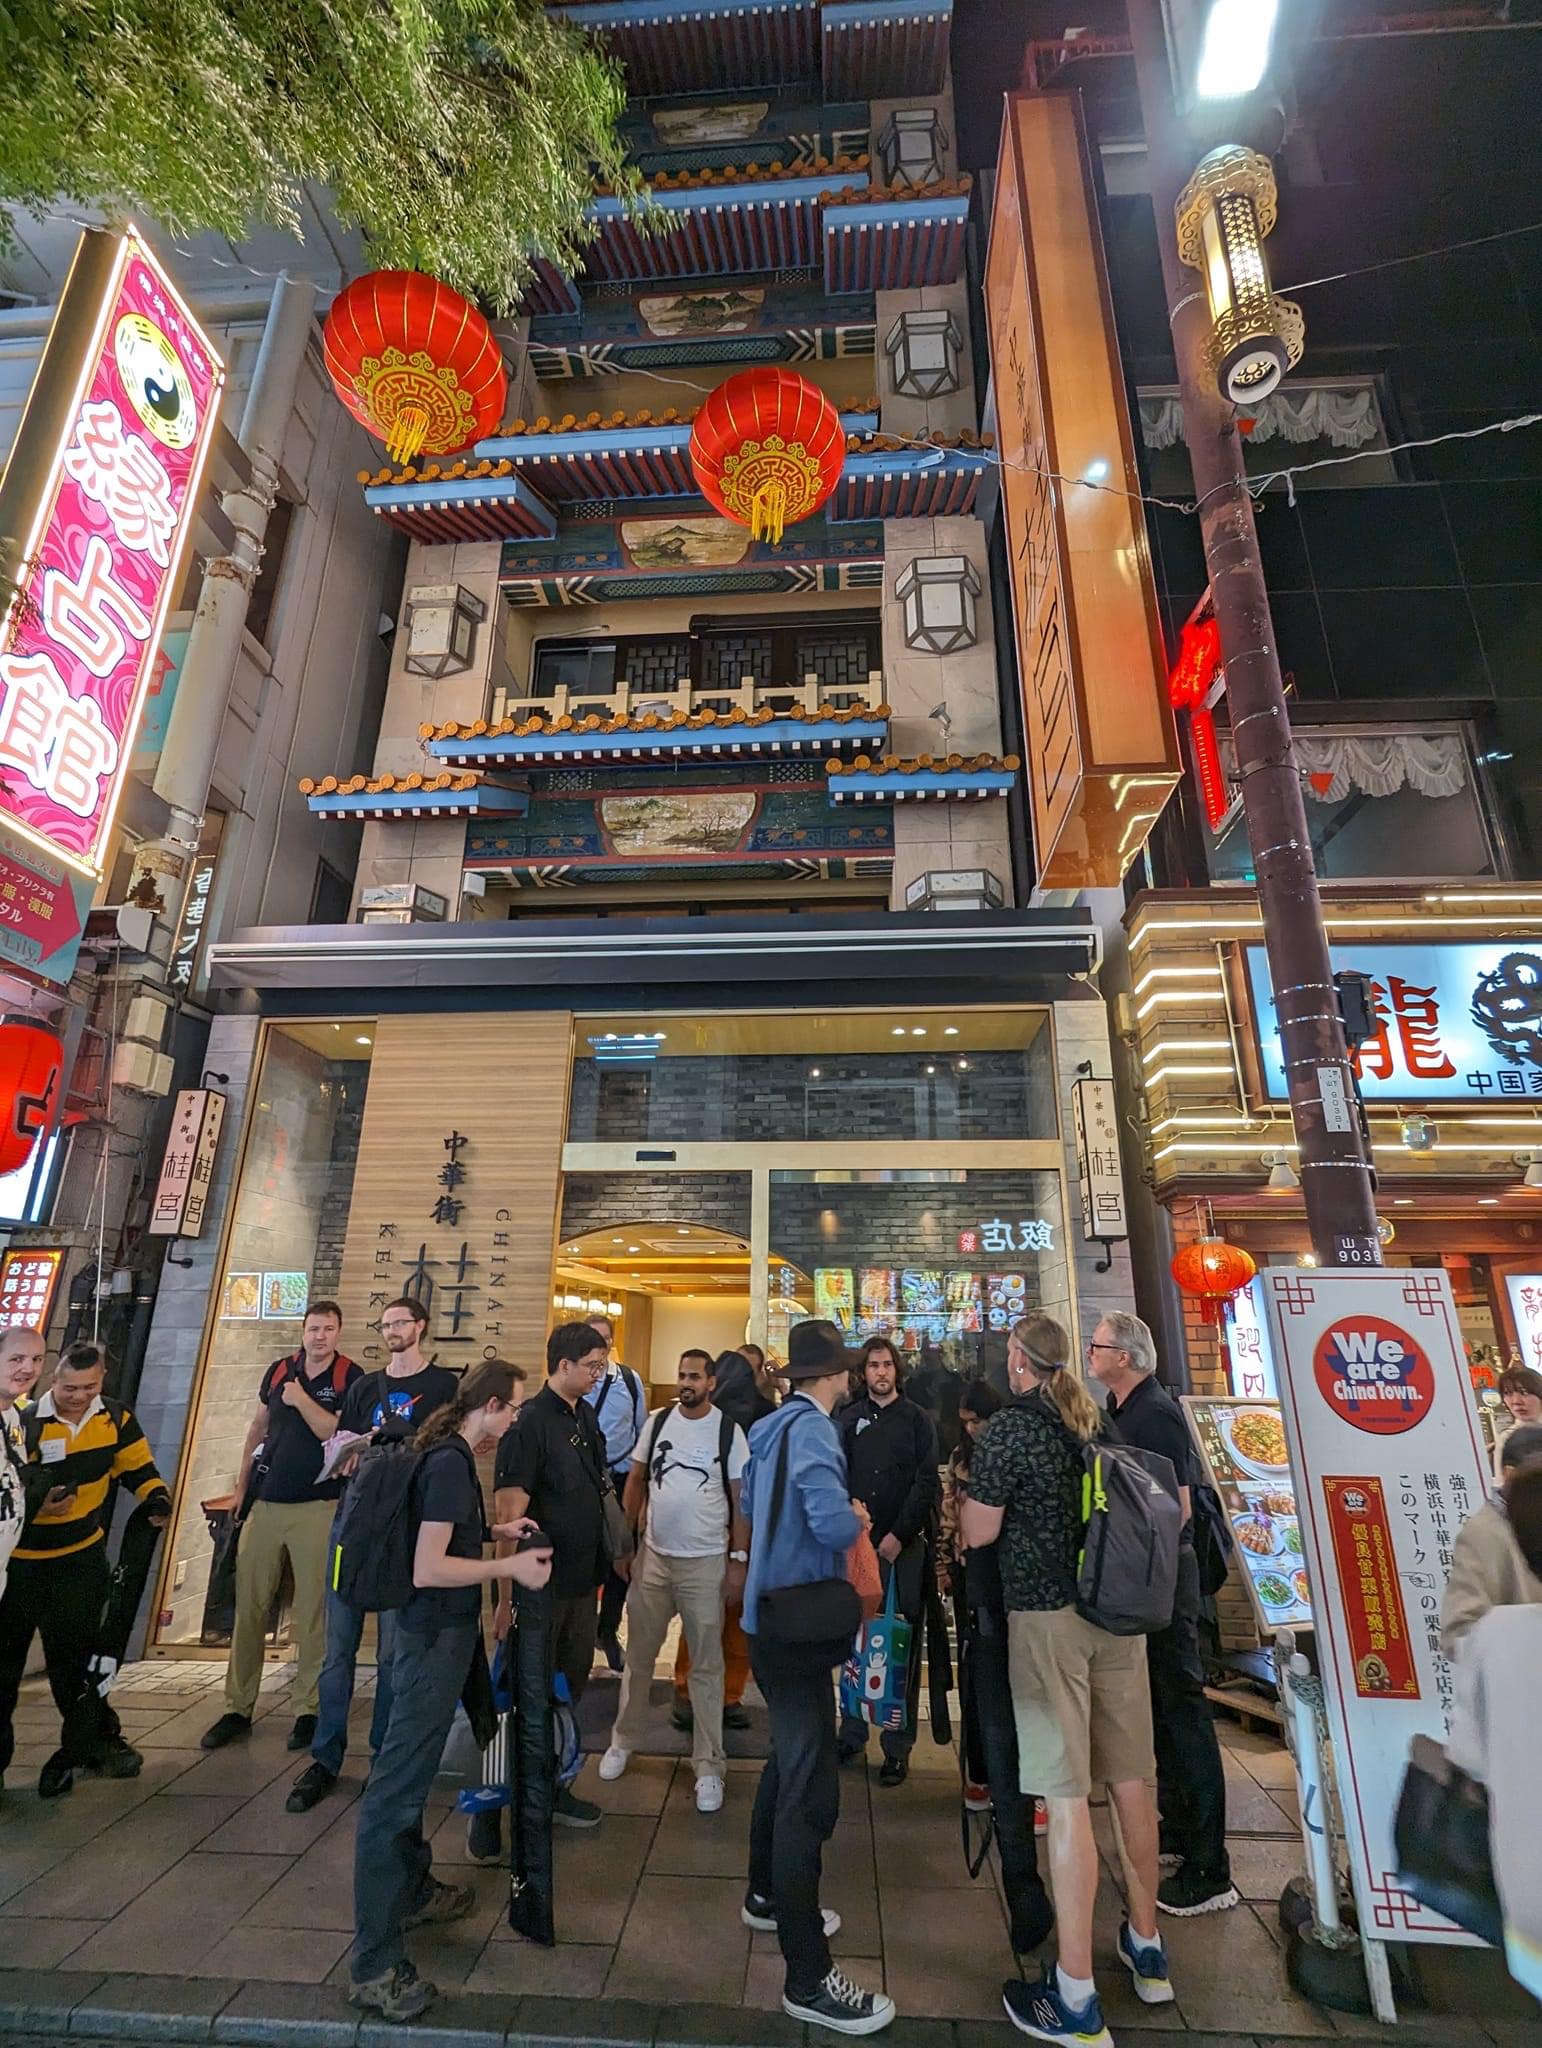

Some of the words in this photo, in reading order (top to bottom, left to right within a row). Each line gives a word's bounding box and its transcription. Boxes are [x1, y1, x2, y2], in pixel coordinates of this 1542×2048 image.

[0, 400, 178, 818] 縁占館
[0, 882, 55, 921] 服・漢服
[154, 1152, 190, 1221] 桂宮
[186, 1153, 212, 1224] 桂宮
[429, 1129, 469, 1226] 中華街
[1089, 1146, 1122, 1222] 桂宮
[1339, 1250, 1382, 1262] 903B
[1341, 1237, 1375, 1249] 山下
[361, 1222, 398, 1360] KEIKYU
[1331, 1332, 1405, 1363] We
[1347, 1363, 1401, 1380] are
[1399, 1475, 1427, 1564] このマーク
